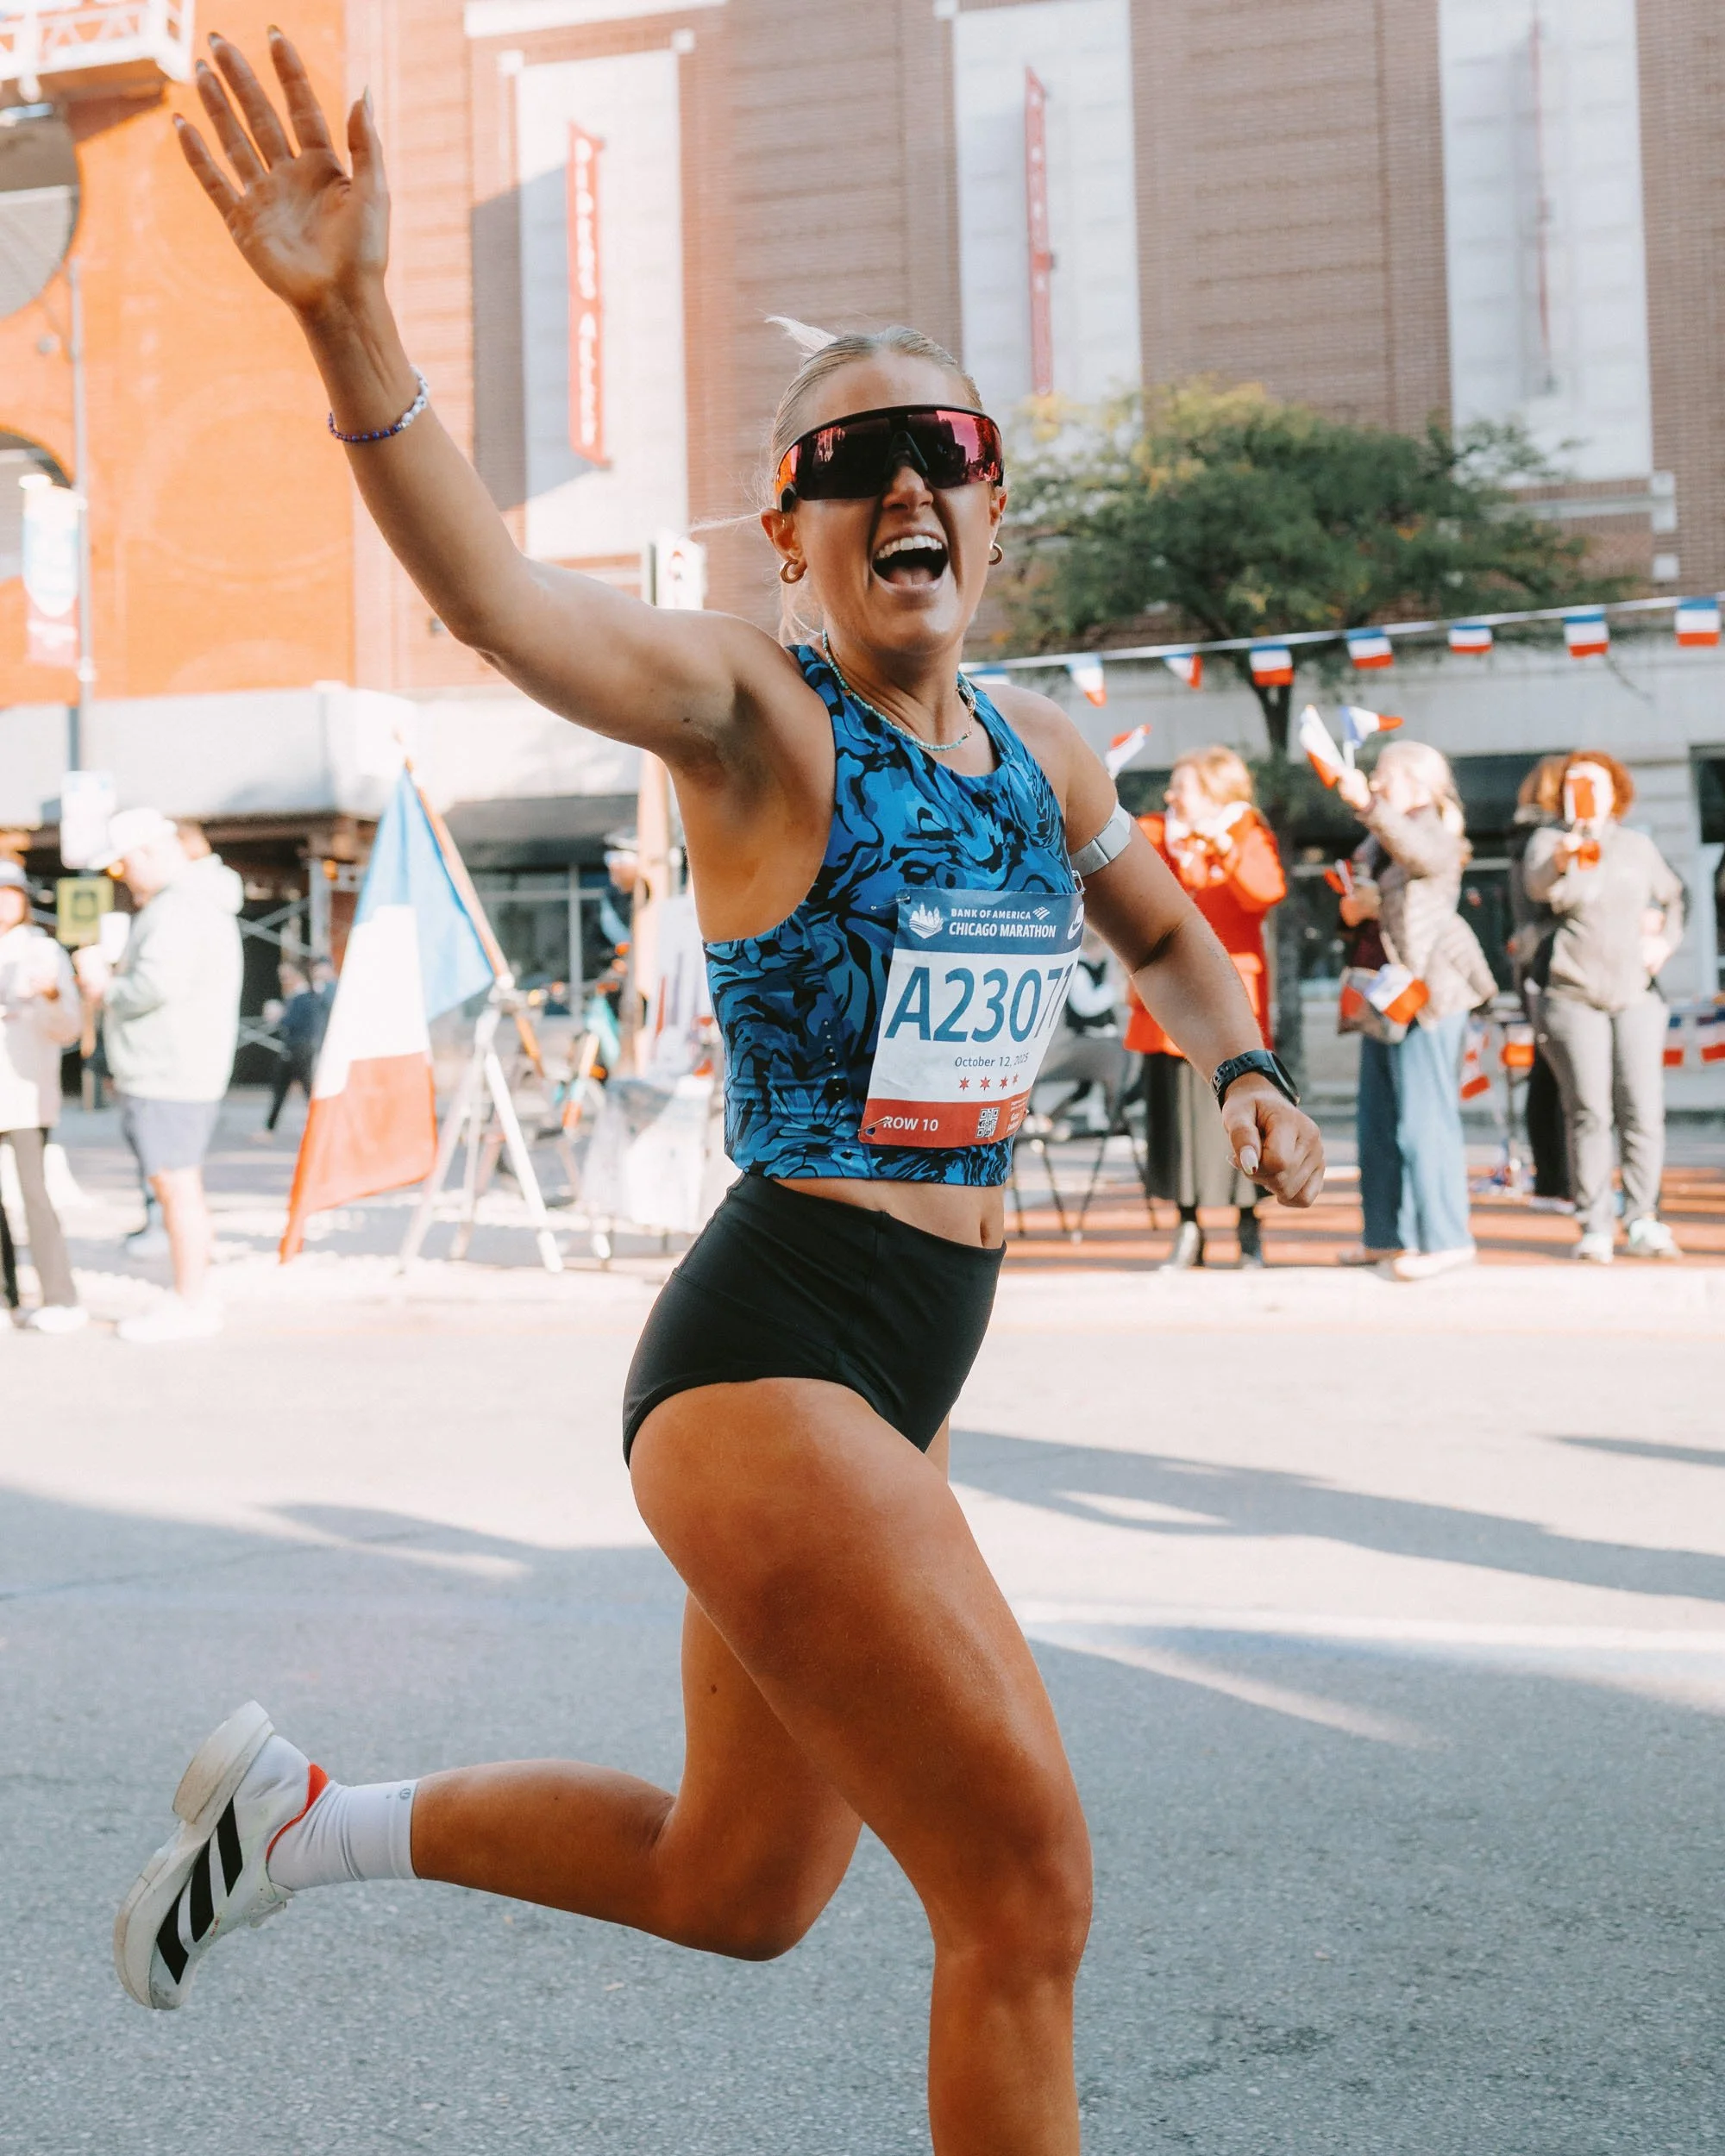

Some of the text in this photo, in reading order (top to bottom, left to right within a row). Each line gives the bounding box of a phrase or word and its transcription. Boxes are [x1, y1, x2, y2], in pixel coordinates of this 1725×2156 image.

[950, 908, 1032, 920] BANK OF AMERICA
[949, 922, 1057, 938] CHICAGO MARATHON
[955, 1056, 996, 1068] October
[999, 1056, 1013, 1069] 12,
[882, 1115, 939, 1131] ROW 10
